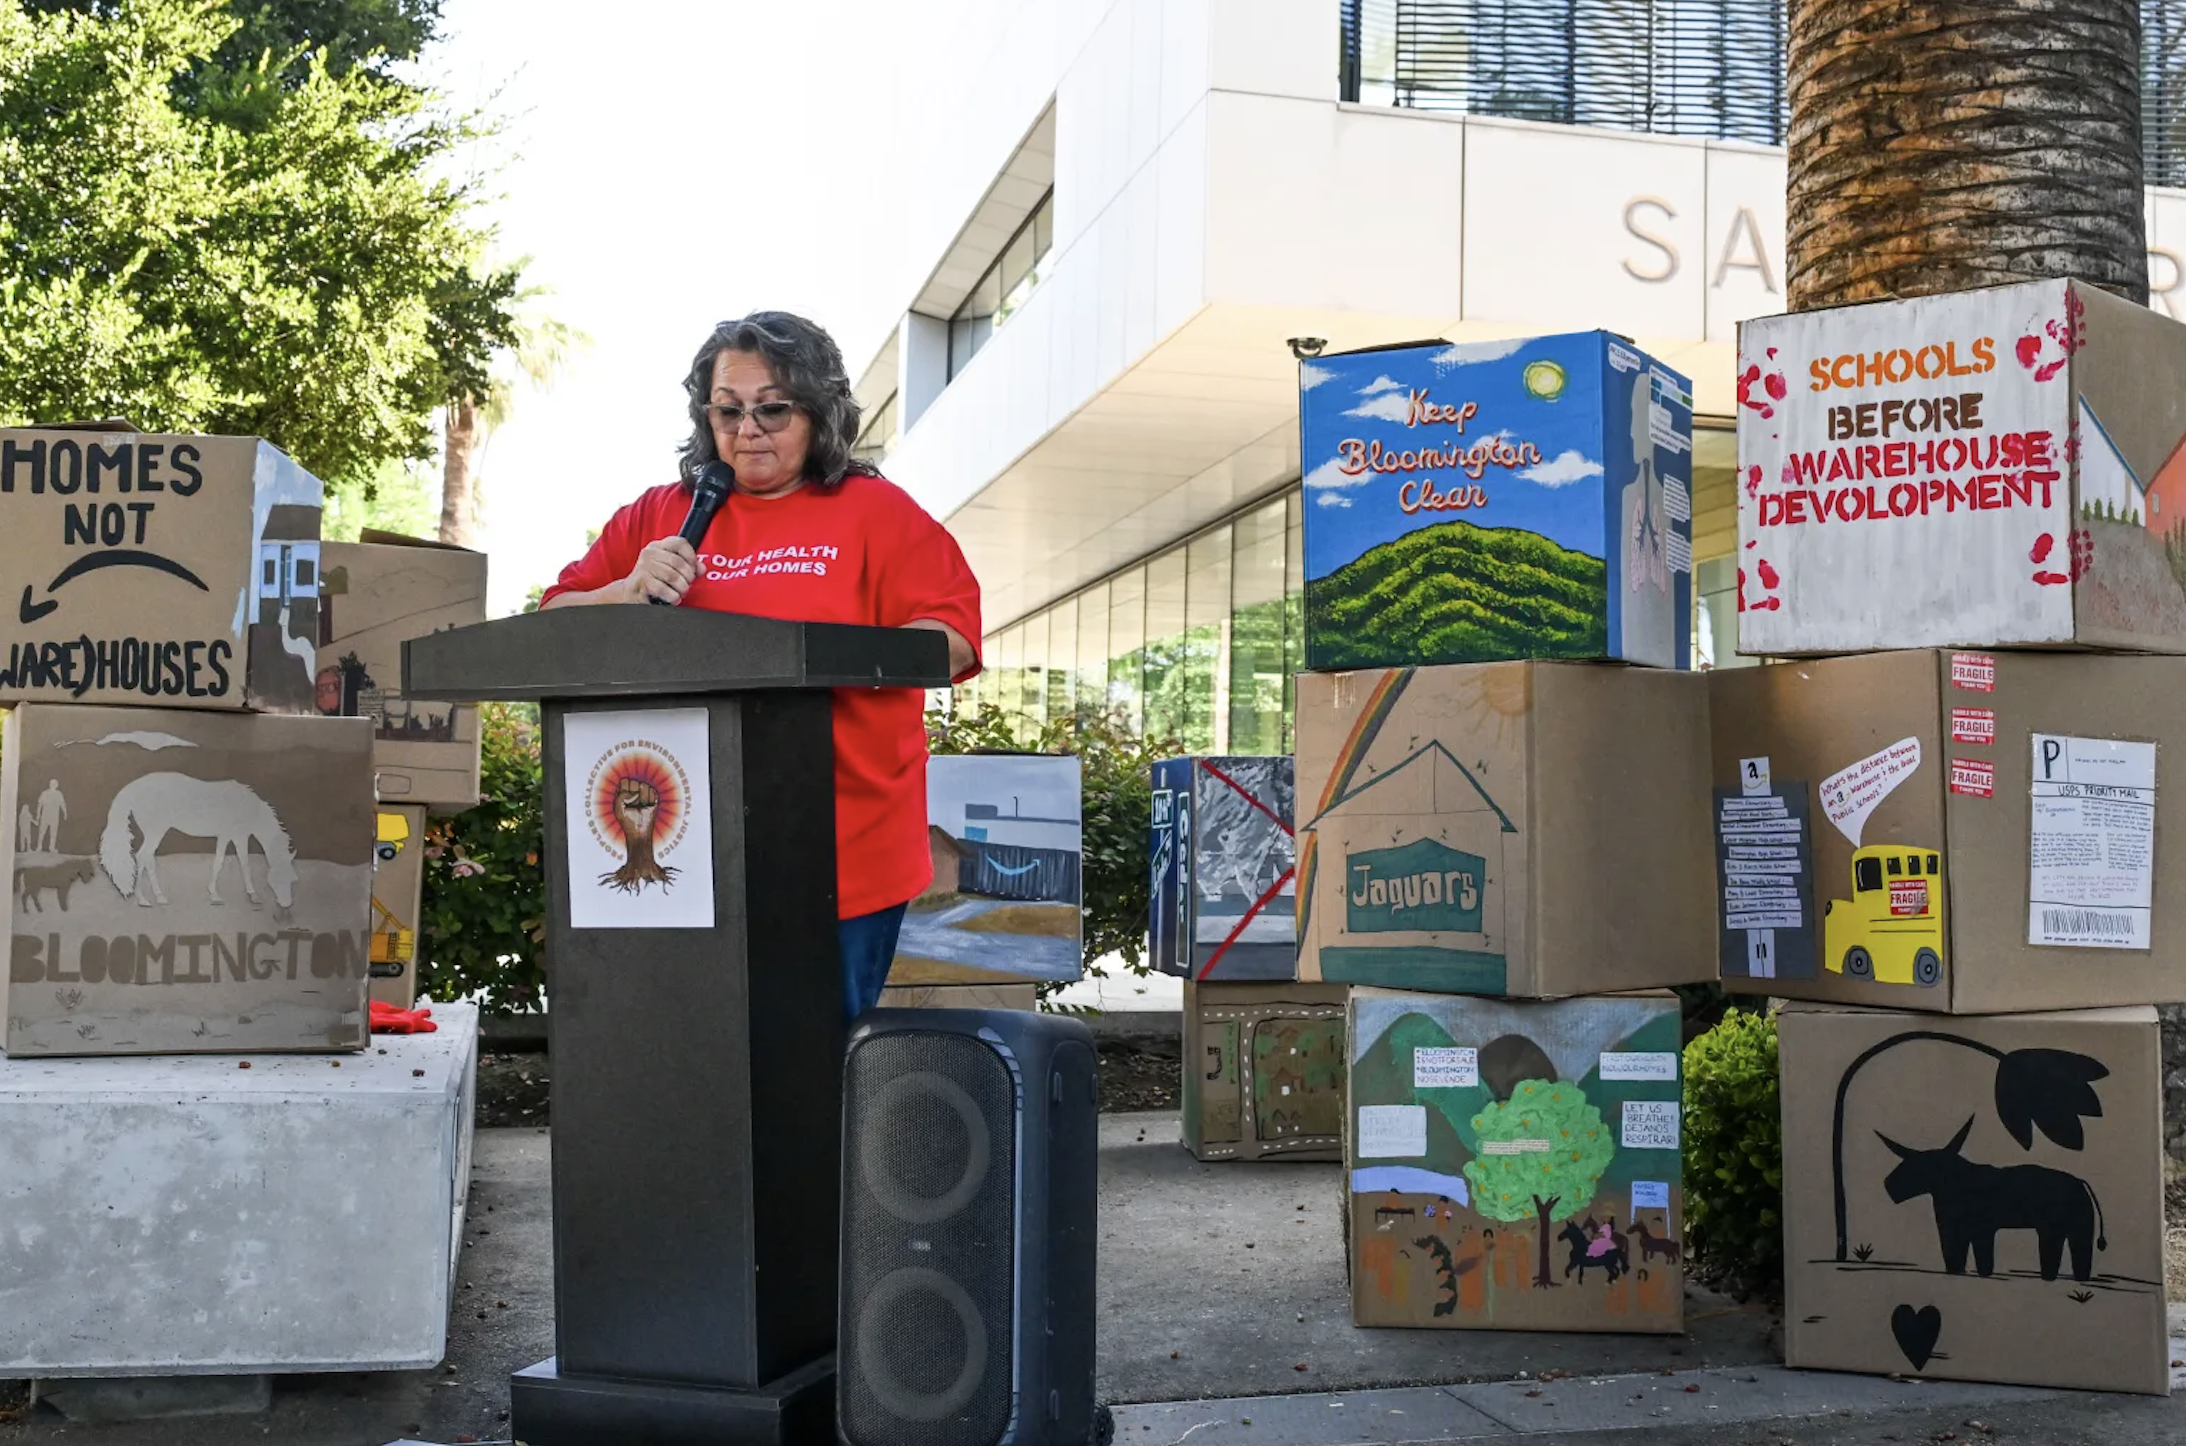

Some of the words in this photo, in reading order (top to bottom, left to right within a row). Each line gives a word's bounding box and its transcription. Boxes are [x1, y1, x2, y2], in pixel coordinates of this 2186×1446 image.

[1621, 194, 1779, 294] SA
[1809, 336, 1996, 392] SCHOOLS
[1404, 387, 1479, 434] Keep
[1828, 392, 1984, 441] BEFORE
[1, 439, 202, 496] HOMES
[1337, 437, 1542, 479] Bloomington
[1788, 430, 2053, 486] WAREHOUSE
[1759, 470, 2060, 527] DEVOLOPMENT
[65, 503, 155, 546] NOT
[706, 568, 749, 581] OUR
[753, 561, 827, 576] HOMES
[711, 554, 753, 569] OUR
[758, 546, 839, 560] HEALTH
[1953, 666, 1993, 680] FRAGILE
[615, 740, 635, 752] FOR
[1953, 720, 1993, 733] FRAGILE
[637, 739, 691, 816] ENVIRONMENTAL
[1846, 772, 1859, 782] the
[1861, 754, 1889, 774] distance
[1889, 744, 1916, 759] between
[1888, 764, 1899, 774] the
[1952, 771, 1992, 786] FRAGILE
[2043, 740, 2060, 779] P
[585, 749, 613, 818] COLLECTIVE
[2058, 785, 2080, 796] USPS
[2084, 784, 2117, 797] PRIORITY
[2119, 788, 2140, 799] MAIL
[658, 818, 688, 859] JUSTICE
[1353, 865, 1477, 915] Jaguars
[1891, 893, 1927, 904] FRAGILE
[9, 929, 370, 984] BLOOMINGTON
[1625, 1104, 1644, 1113] LET
[1649, 1104, 1662, 1113] US
[1627, 1114, 1674, 1124] BREATHE!
